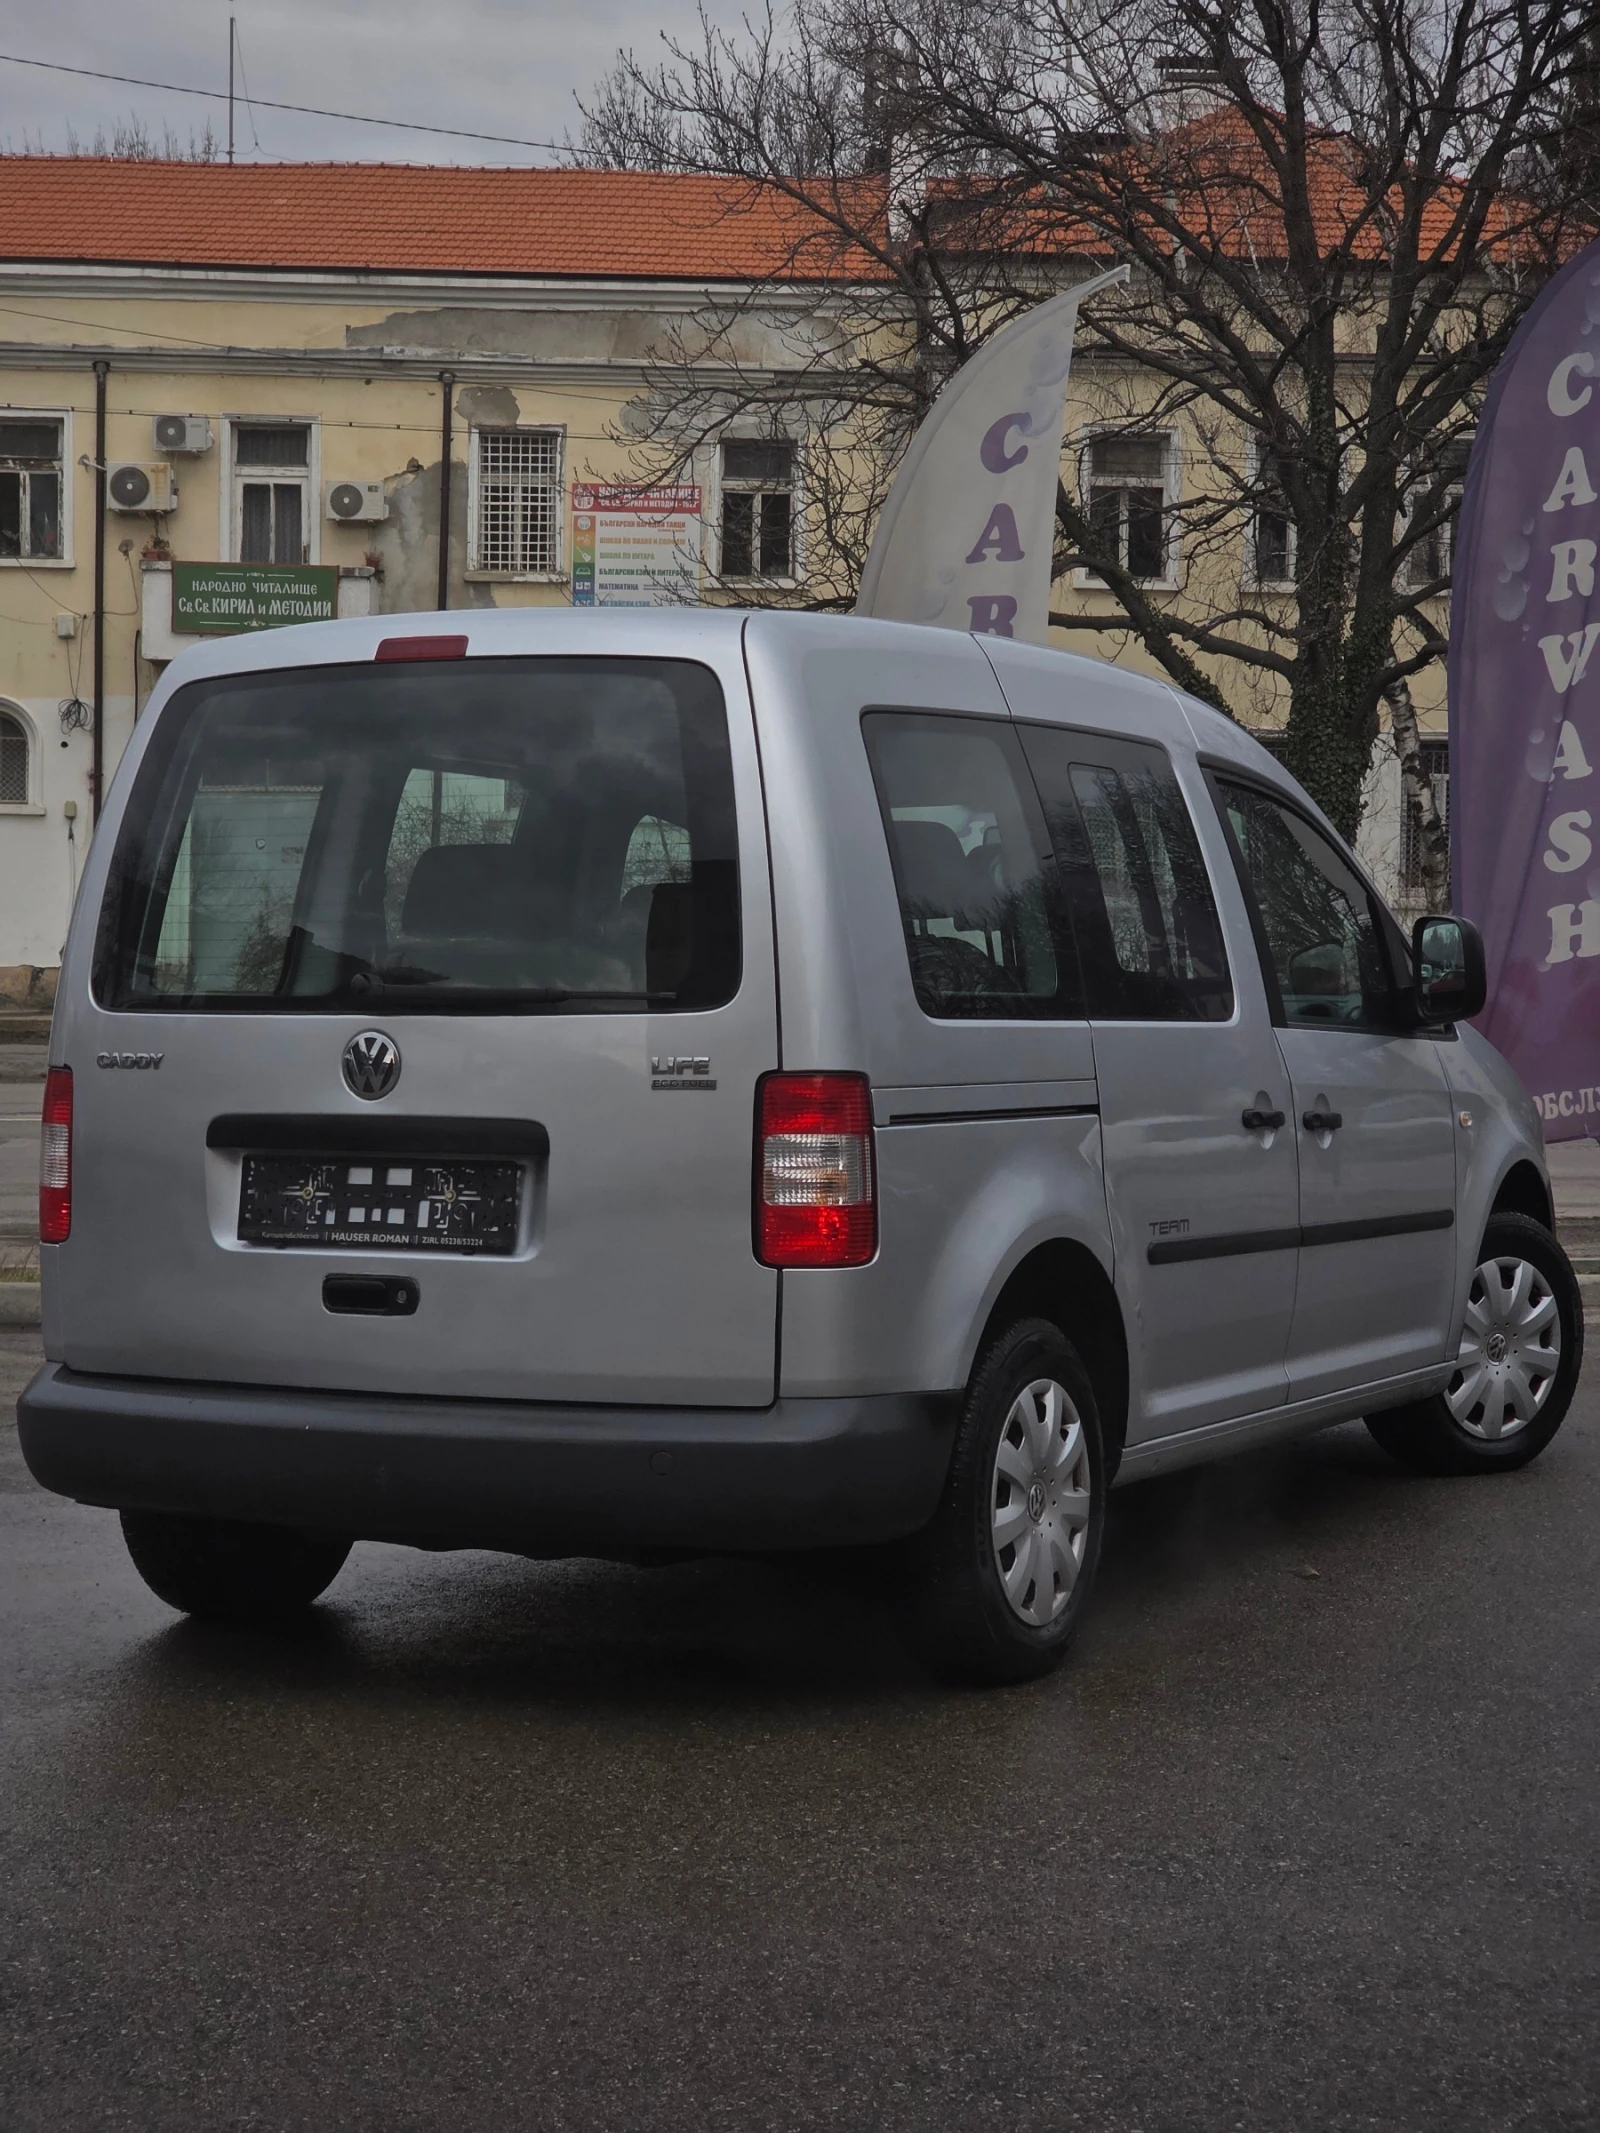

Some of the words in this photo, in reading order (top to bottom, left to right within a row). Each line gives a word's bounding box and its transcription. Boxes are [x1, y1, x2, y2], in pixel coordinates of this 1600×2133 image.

[599, 568, 635, 576] БЪЛГАРСКИ
[192, 580, 247, 593] НАРОДНО
[598, 583, 639, 591] МАТЕМАТИКА
[97, 1051, 164, 1070] CADDY
[651, 1056, 710, 1075] LIFE
[1148, 1218, 1190, 1236] TEAM
[331, 1232, 370, 1242] HAUSER
[372, 1233, 409, 1244] ROMAN
[421, 1236, 439, 1244] ZIRL
